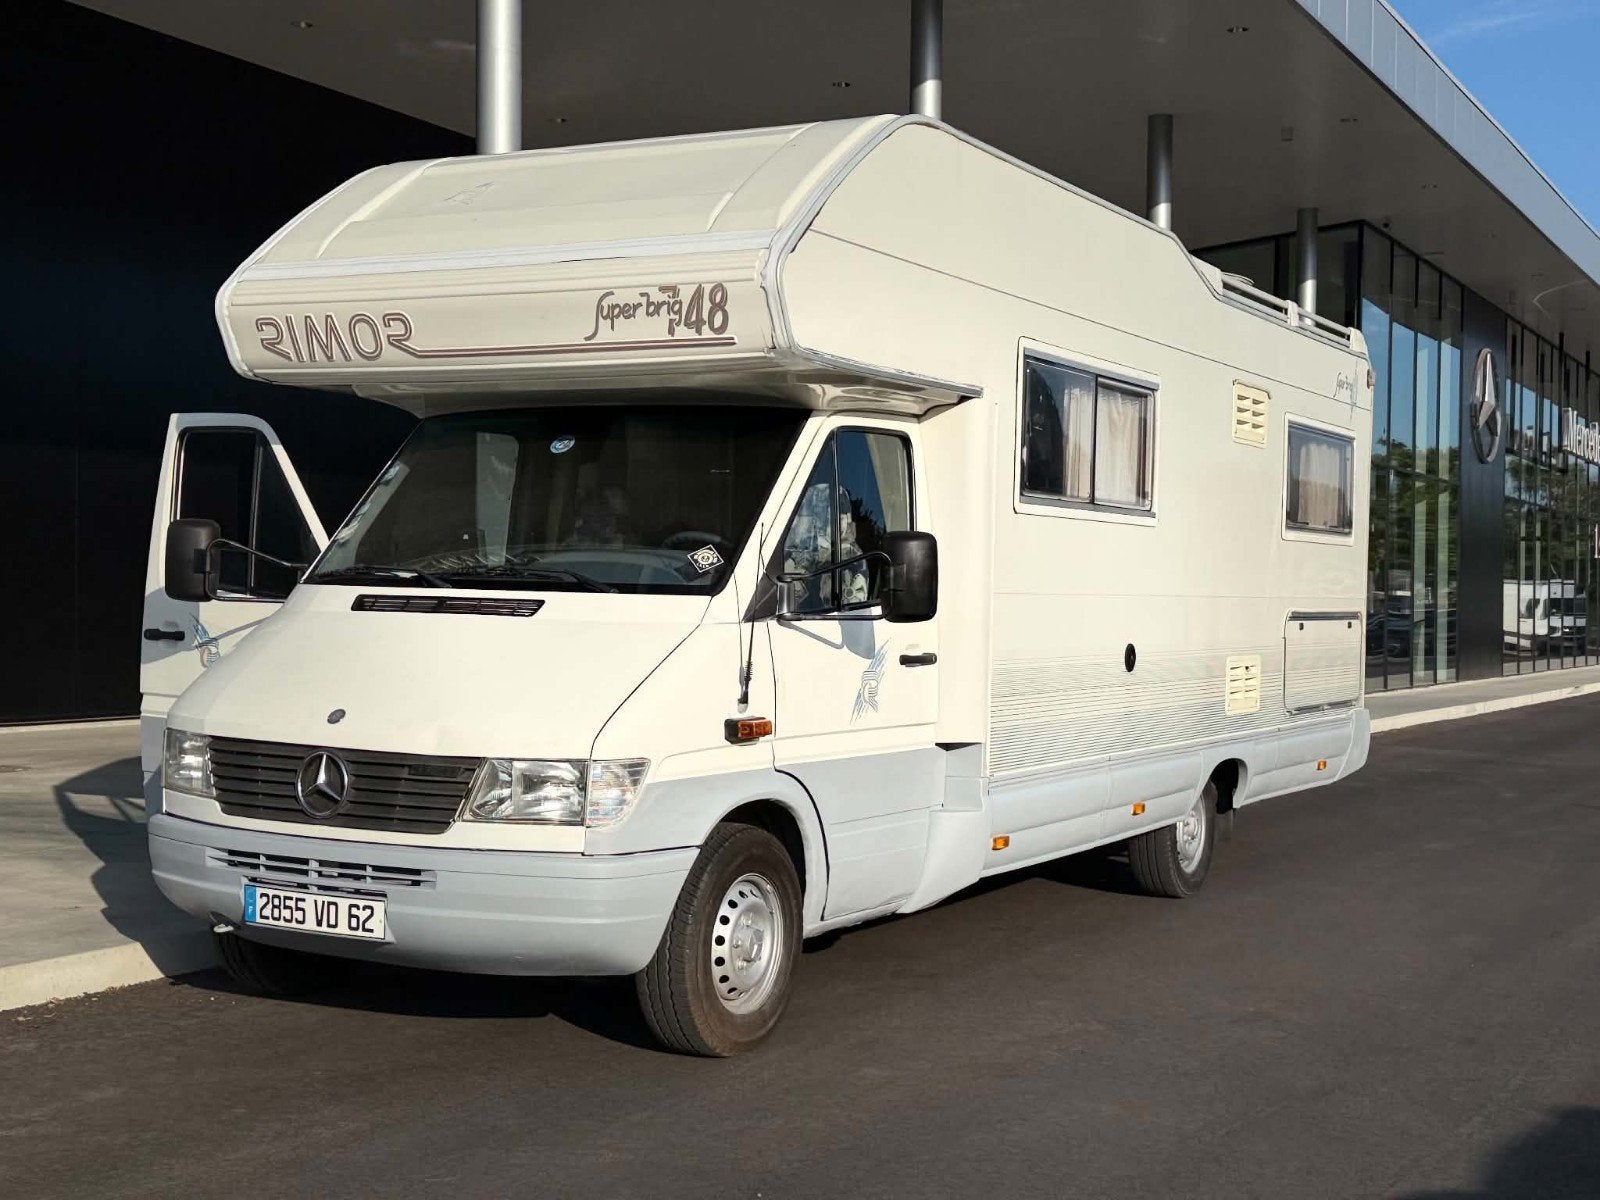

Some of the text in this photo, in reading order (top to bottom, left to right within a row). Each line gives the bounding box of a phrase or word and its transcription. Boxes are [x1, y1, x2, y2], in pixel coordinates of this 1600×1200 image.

[684, 283, 729, 335] 48
[255, 311, 420, 362] RIMOR
[259, 892, 375, 933] 2855 VD 62
